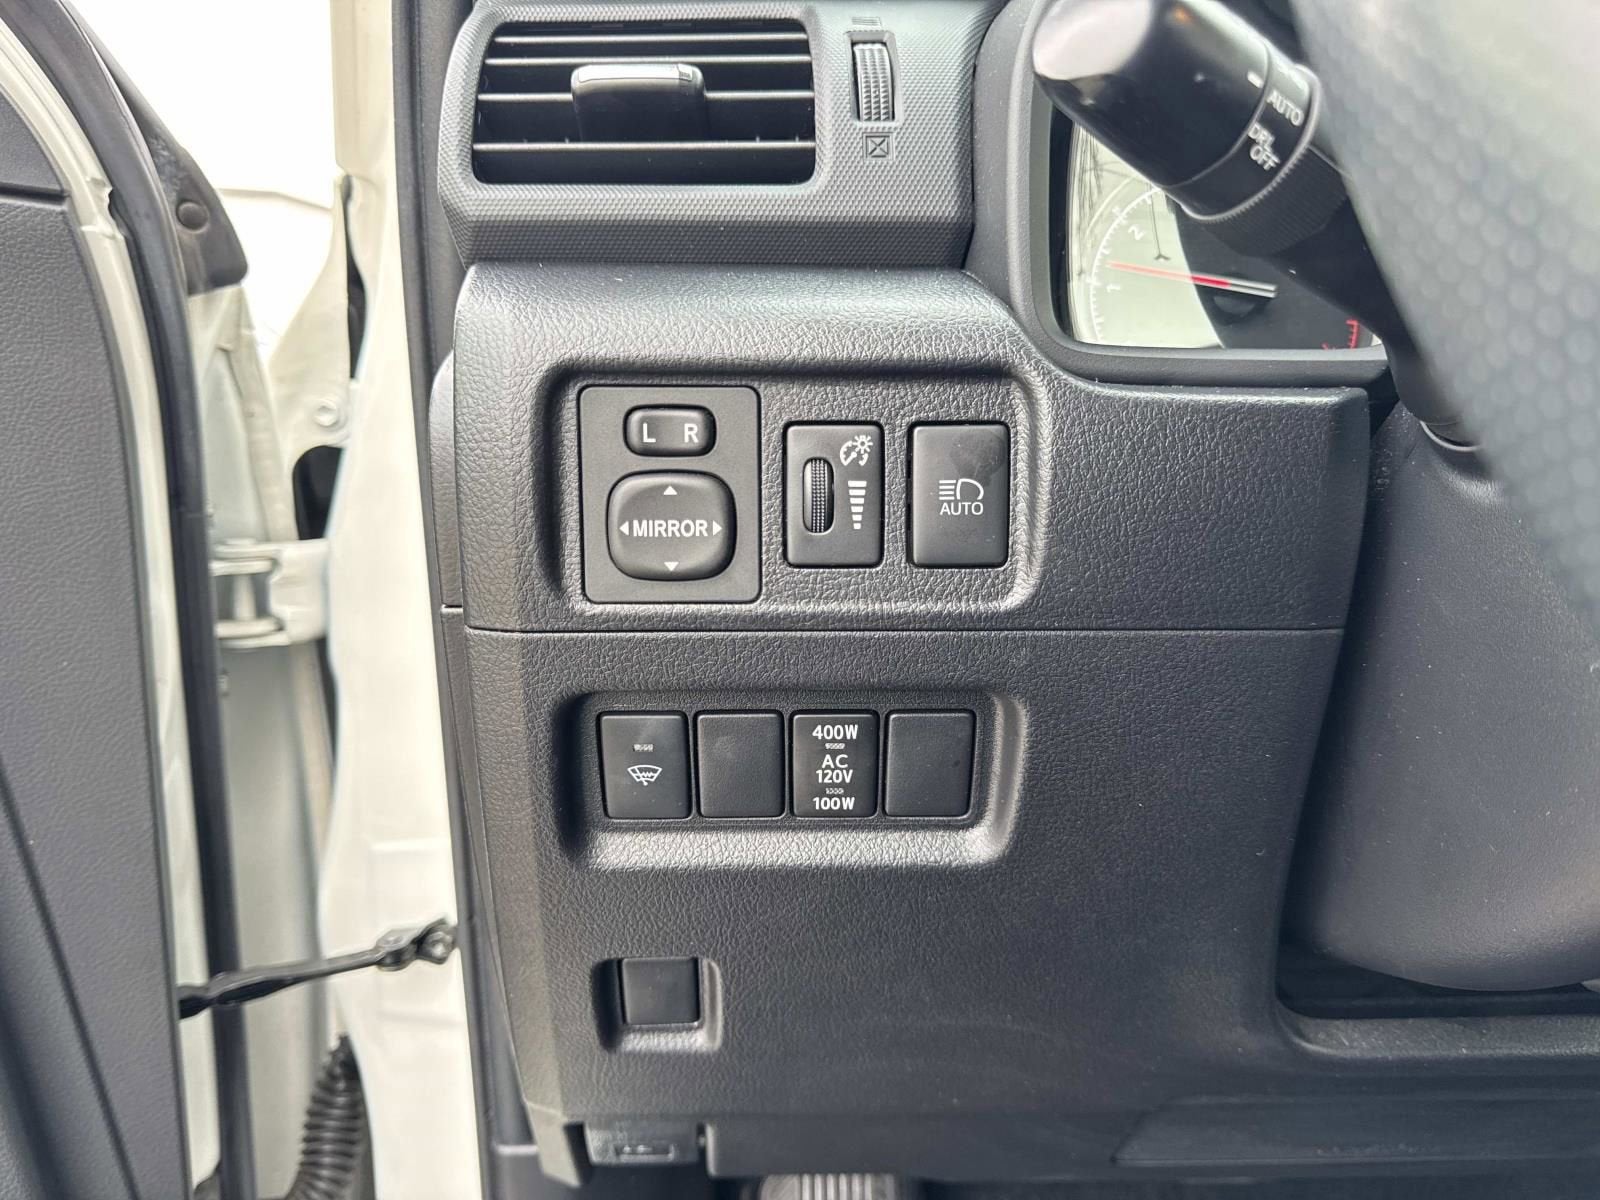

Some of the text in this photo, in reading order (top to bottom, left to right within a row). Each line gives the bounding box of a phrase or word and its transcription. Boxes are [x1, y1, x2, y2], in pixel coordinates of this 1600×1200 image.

[1266, 89, 1304, 127] AUTO
[1249, 144, 1280, 171] OFF
[1127, 223, 1145, 241] 2
[642, 423, 699, 444] L R
[939, 501, 984, 516] AUTO
[632, 518, 709, 538] MIRROR
[811, 724, 859, 741] 400W
[821, 753, 849, 769] AC
[815, 769, 854, 785] 120V
[812, 796, 856, 811] 100W
